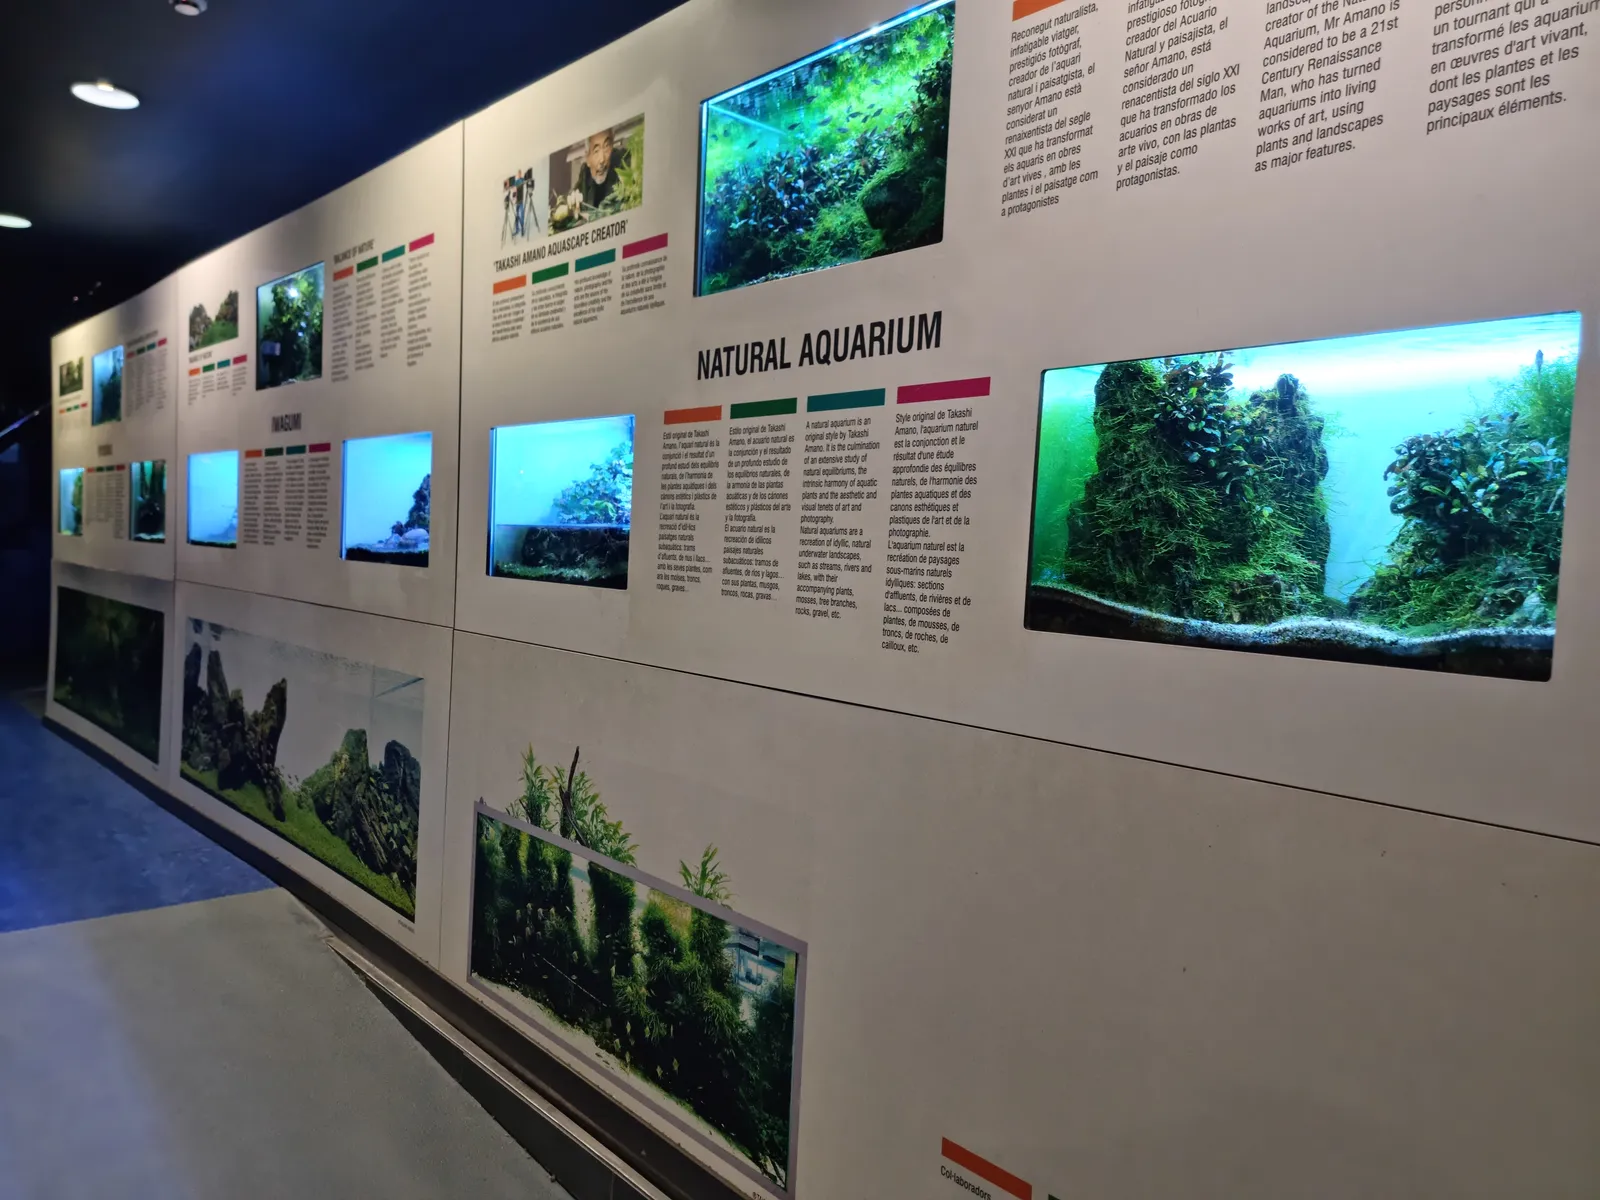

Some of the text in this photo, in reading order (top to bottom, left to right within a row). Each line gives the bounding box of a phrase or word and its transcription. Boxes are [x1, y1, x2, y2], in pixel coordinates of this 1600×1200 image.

[1011, 17, 1052, 41] Reconegut
[1126, 7, 1217, 44] creador del Acuario
[1127, 4, 1177, 32] prestigioso
[1264, 24, 1319, 49] Aquarium,
[1324, 15, 1340, 30] Mr
[1343, 4, 1386, 25] Amano
[1265, 11, 1304, 32] creator
[1307, 4, 1318, 19] of
[1321, 0, 1339, 14] the
[1433, 22, 1449, 36] un
[1453, 2, 1510, 31] tournant
[1010, 34, 1049, 56] infatigable
[1125, 17, 1228, 60] Natural y paisajista, el
[1263, 16, 1399, 65] considered to be a 21st
[1430, 60, 1446, 73] en
[1450, 46, 1500, 68] œuvres
[1540, 21, 1587, 45] vivant,
[1432, 23, 1505, 56] transformé
[1509, 20, 1529, 35] les
[1008, 69, 1038, 85] creador
[1039, 64, 1049, 75] de
[1009, 50, 1046, 74] prestigiós
[1124, 39, 1212, 76] señor Amano, está
[1261, 41, 1382, 83] Century Renaissance
[1429, 45, 1579, 93] dont les plantes et les
[1122, 63, 1239, 108] renacentista del siglo XXI
[1123, 63, 1194, 92] considerado un
[1260, 56, 1381, 101] Man, who has turned
[1428, 73, 1550, 116] paysages sont les
[1120, 84, 1236, 127] que ha transformado los
[1259, 79, 1376, 120] aquariums into living
[1426, 90, 1566, 135] principaux éléments.
[1119, 104, 1217, 140] acuarios en obras de
[1256, 113, 1383, 157] plants and landscapes
[1257, 100, 1364, 136] works of art, using
[1118, 117, 1236, 156] arte vivo, con las plantas
[1117, 143, 1198, 175] y el paisaje como
[1255, 139, 1355, 171] as major features.
[1116, 165, 1180, 191] protagonistas.
[522, 247, 546, 266] AMANO
[547, 231, 590, 257] AQUASCAPE
[697, 310, 943, 381] NATURAL AQUARIUM
[805, 420, 810, 429] A
[810, 419, 829, 429] natural
[829, 418, 856, 429] aquarium
[856, 417, 862, 426] is
[895, 407, 972, 424] Style original de Takashi
[954, 420, 978, 431] naturel
[804, 428, 869, 442] original style by Takashi
[825, 442, 830, 451] It
[830, 443, 836, 451] is
[836, 442, 846, 451] the
[846, 441, 880, 450] culmination
[893, 435, 965, 449] est la conjonction et le
[891, 461, 976, 476] approfondie des équilibres
[892, 450, 916, 460] résultat
[935, 448, 954, 459] étude
[890, 488, 971, 501] plantes aquatiques et des
[918, 476, 927, 485] de
[964, 475, 977, 484] des
